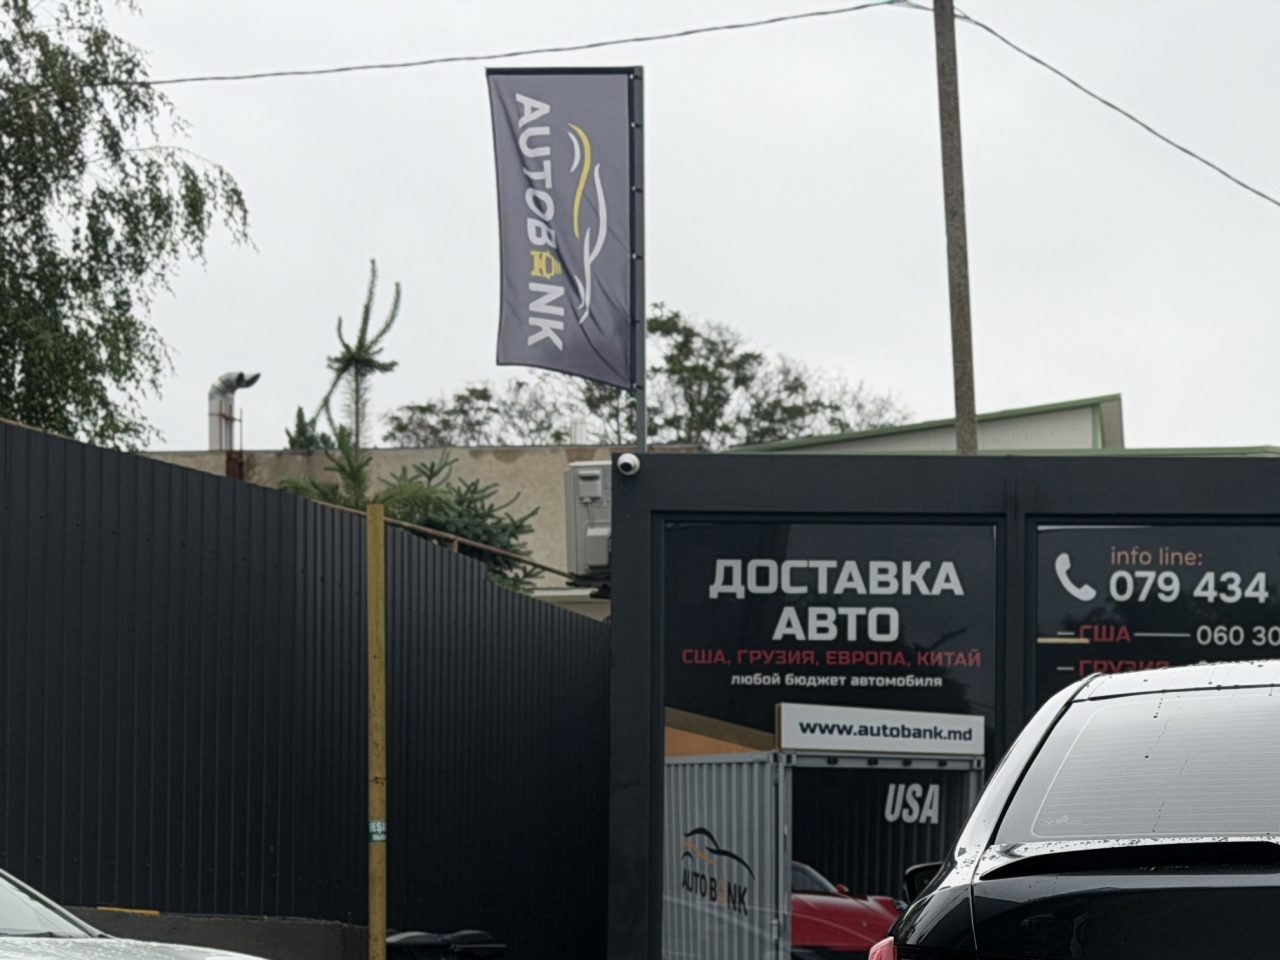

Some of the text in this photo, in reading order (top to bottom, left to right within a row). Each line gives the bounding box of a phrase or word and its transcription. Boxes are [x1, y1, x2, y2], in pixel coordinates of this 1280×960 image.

[1110, 547, 1203, 566] info line:
[709, 559, 964, 599] ДОСТАВКА
[1109, 571, 1181, 602] 079
[1193, 572, 1269, 603] 434
[772, 606, 900, 642] АВТО
[1079, 625, 1132, 643] США
[1196, 626, 1245, 646] 060
[682, 649, 981, 668] США, ГРУЗИЯ, ЕВРОПА, КИТАЙ
[731, 673, 942, 688] любой бюджет автомобиля
[799, 721, 974, 742] www.autobank.md
[884, 783, 941, 824] USA
